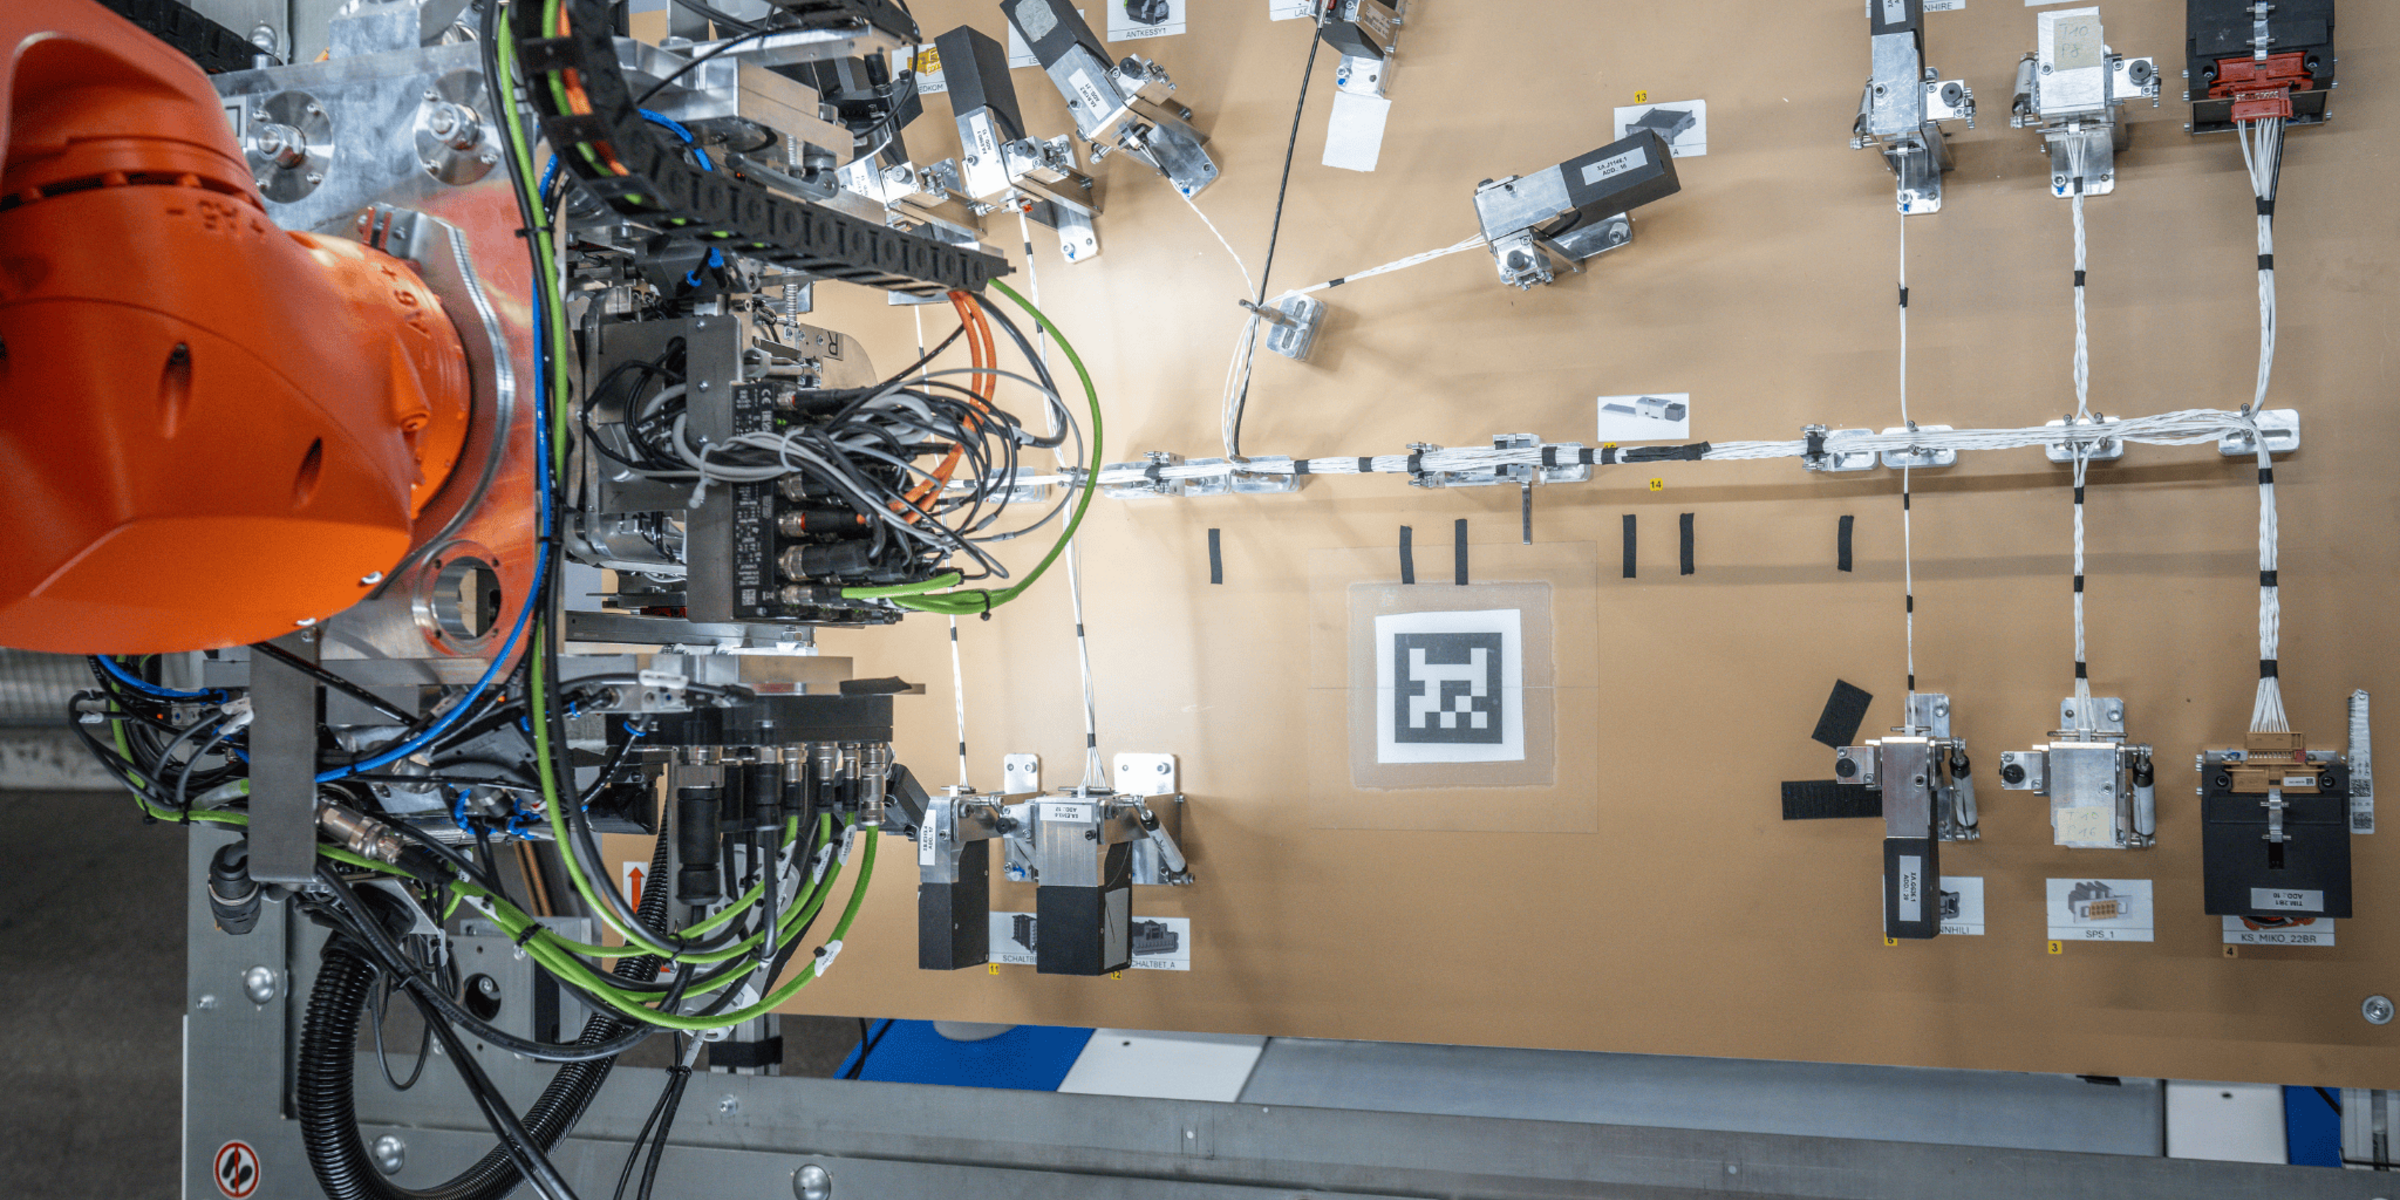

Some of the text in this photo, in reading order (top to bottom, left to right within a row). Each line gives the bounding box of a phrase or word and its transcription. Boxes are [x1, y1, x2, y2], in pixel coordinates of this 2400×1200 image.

[1126, 27, 1167, 38] ANTKESSY1
[1636, 92, 1647, 102] 13
[827, 331, 839, 356] R
[1650, 480, 1662, 489] 14
[2085, 929, 2115, 940] SPS_1
[2241, 933, 2317, 944] KS_MIKO_22BR
[2051, 942, 2058, 953] 3
[2226, 946, 2234, 956] 4
